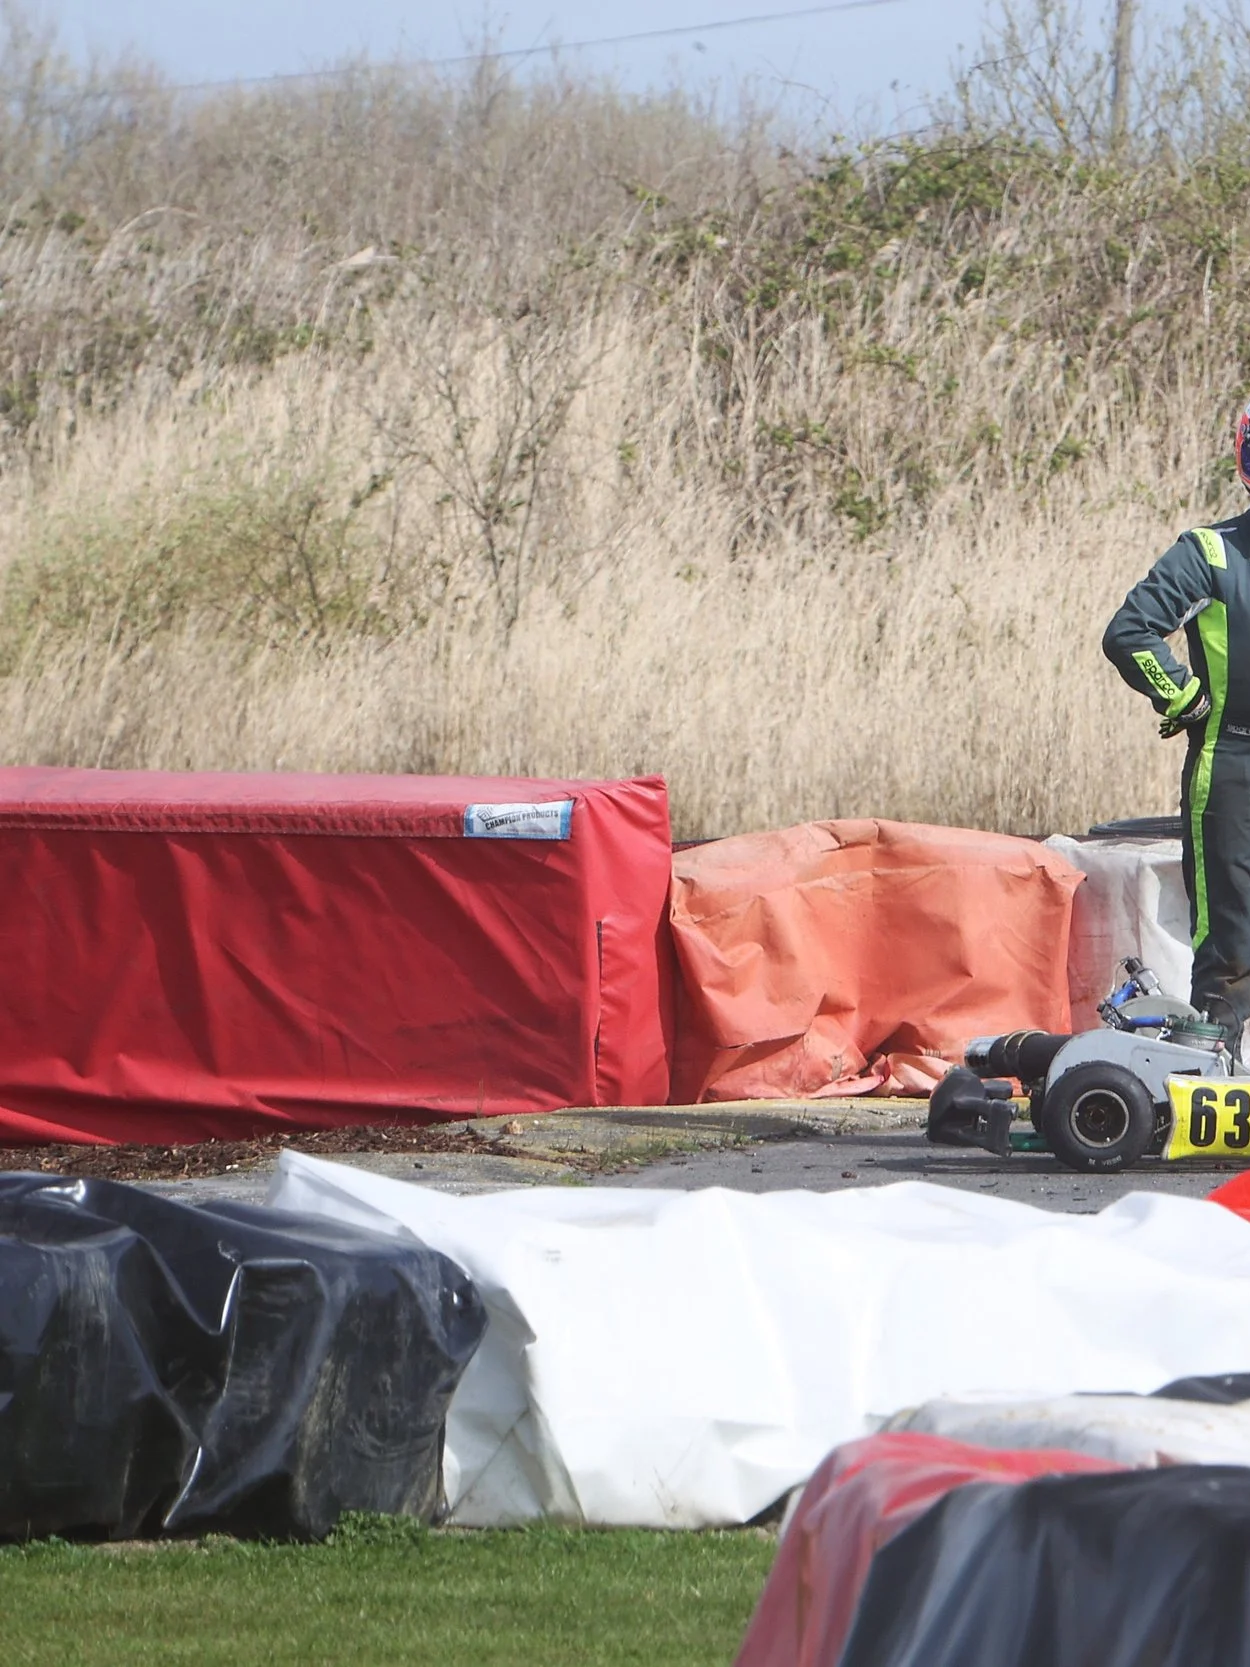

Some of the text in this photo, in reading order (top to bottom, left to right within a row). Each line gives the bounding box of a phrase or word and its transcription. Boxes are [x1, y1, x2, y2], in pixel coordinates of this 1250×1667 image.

[1142, 658, 1176, 697] sparco
[485, 813, 521, 831] CHAMPION
[522, 810, 559, 820] PRODUCTS
[1189, 1087, 1250, 1149] 63
